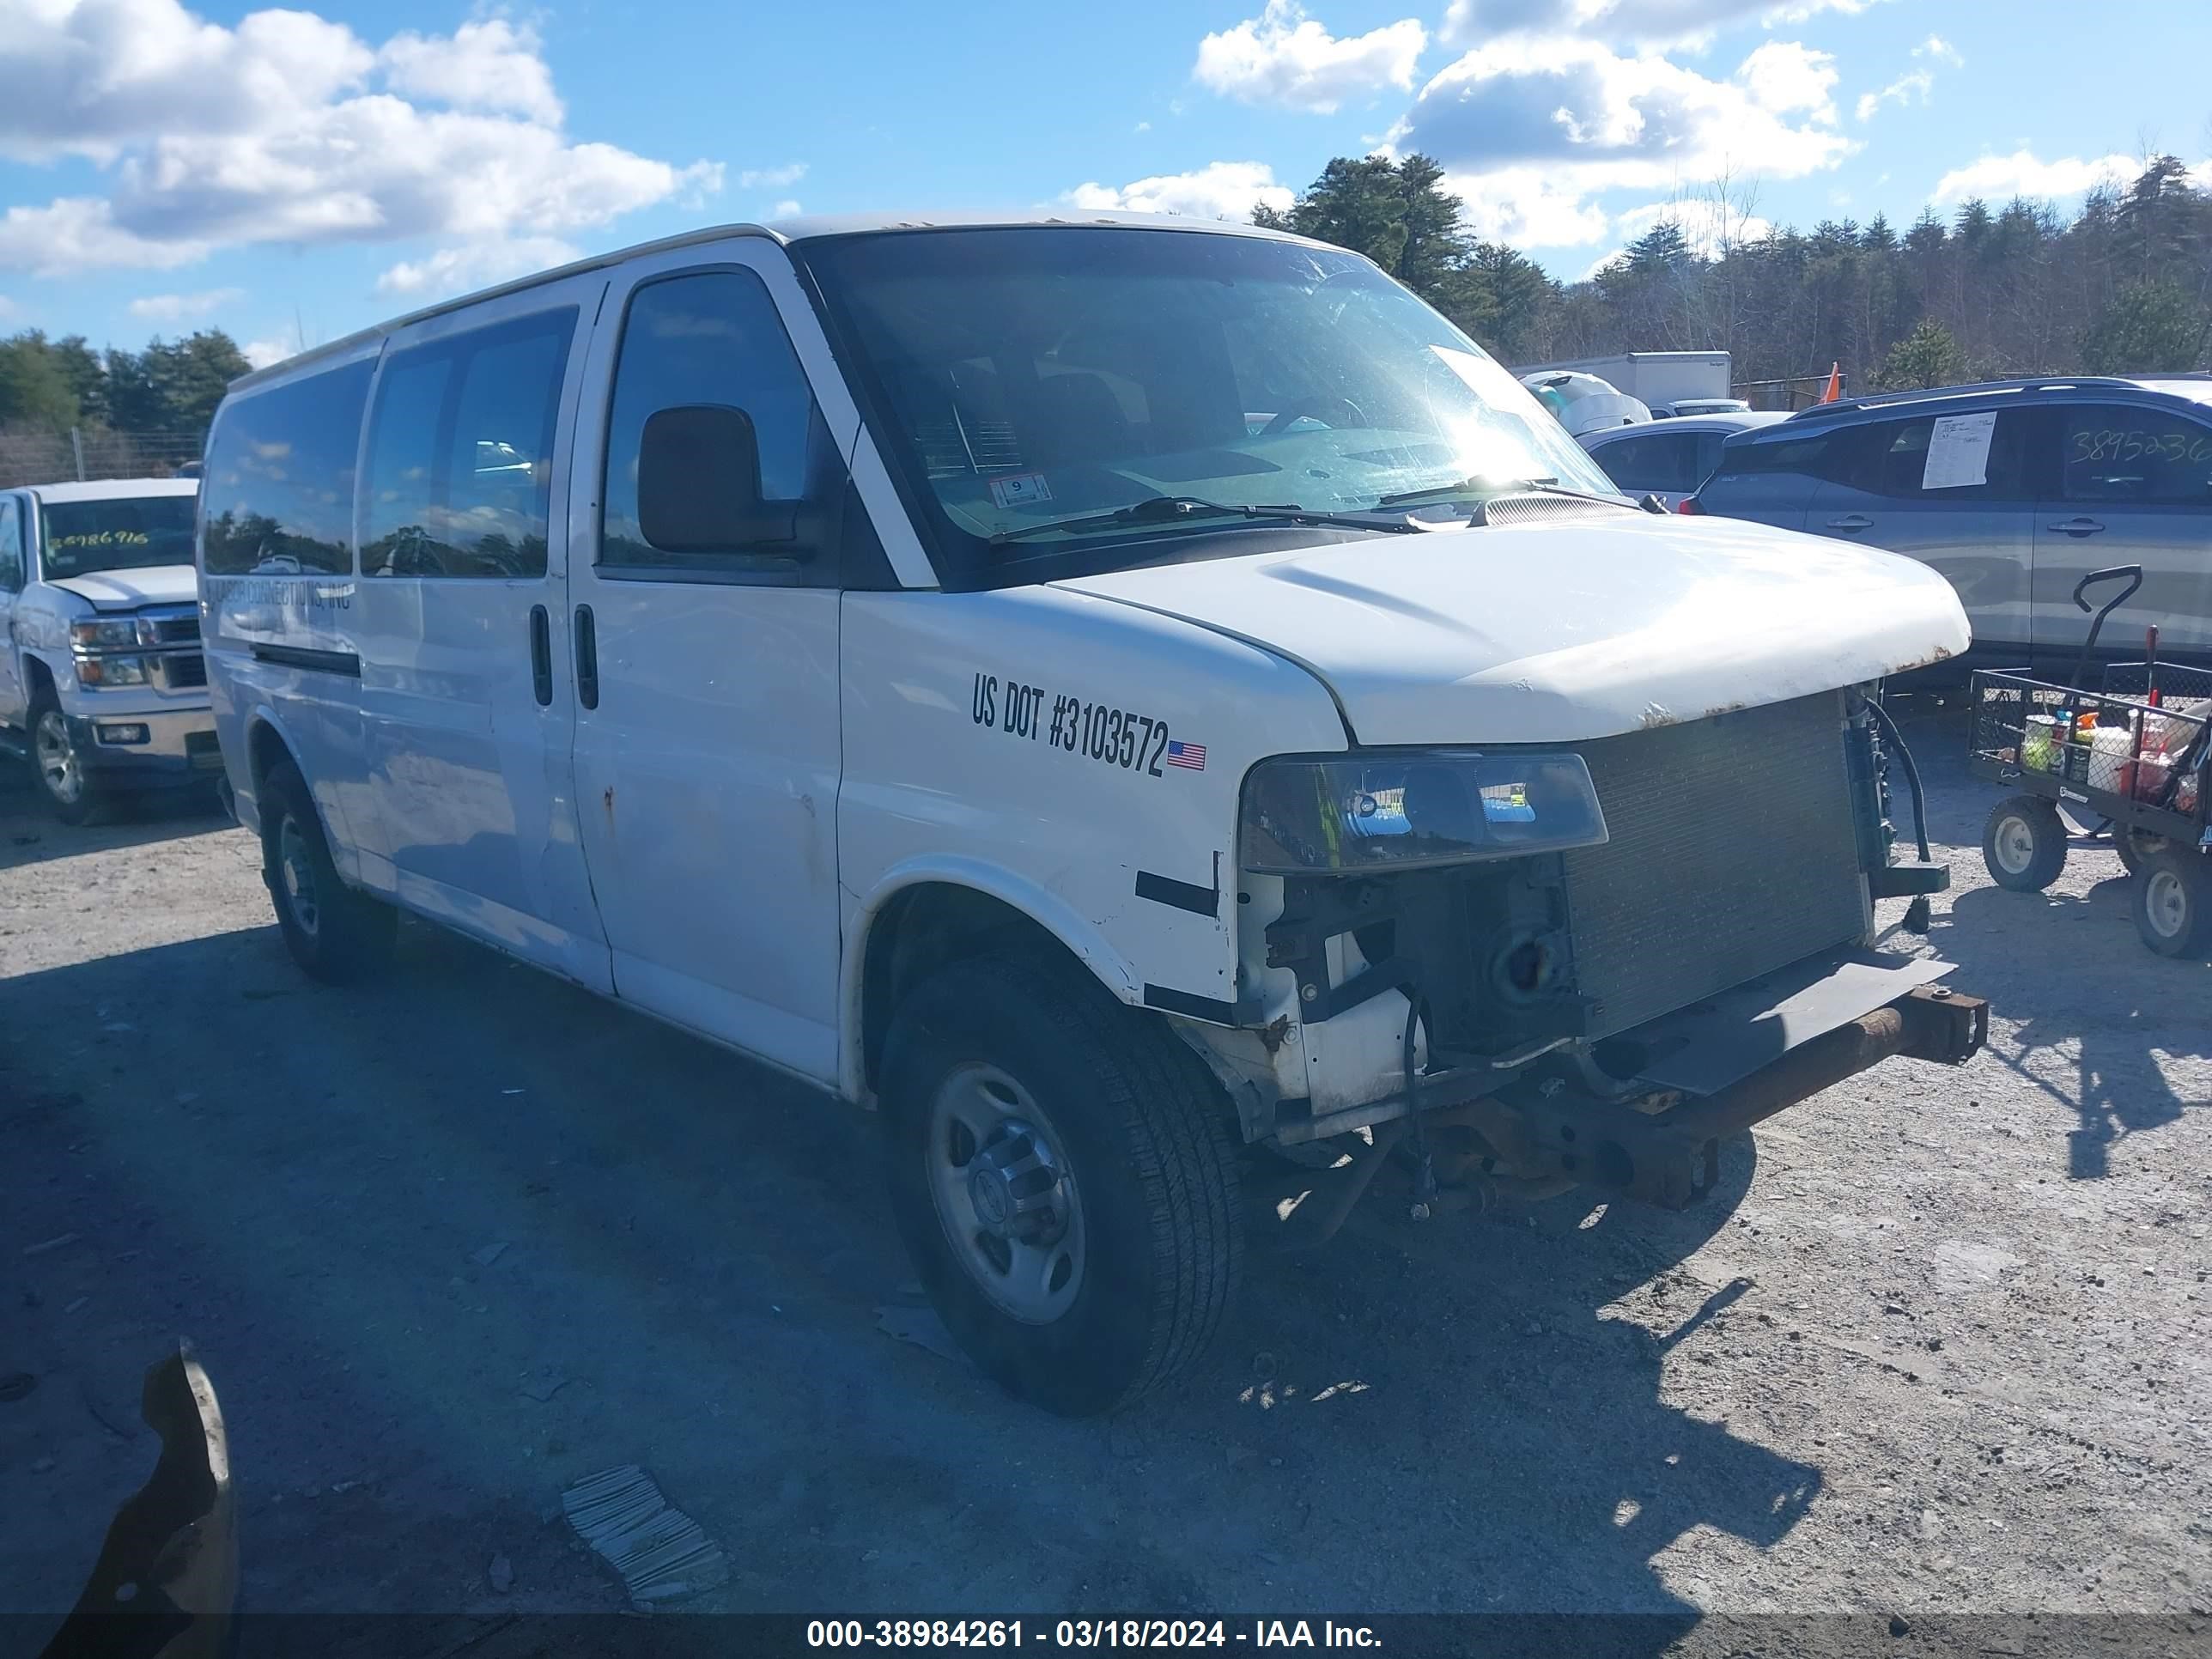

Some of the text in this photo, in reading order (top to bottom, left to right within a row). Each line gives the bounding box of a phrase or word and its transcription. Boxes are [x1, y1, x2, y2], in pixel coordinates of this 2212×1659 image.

[1012, 481, 1022, 491] 9
[329, 582, 350, 610] INC
[972, 672, 1169, 778] US DOT #3103572
